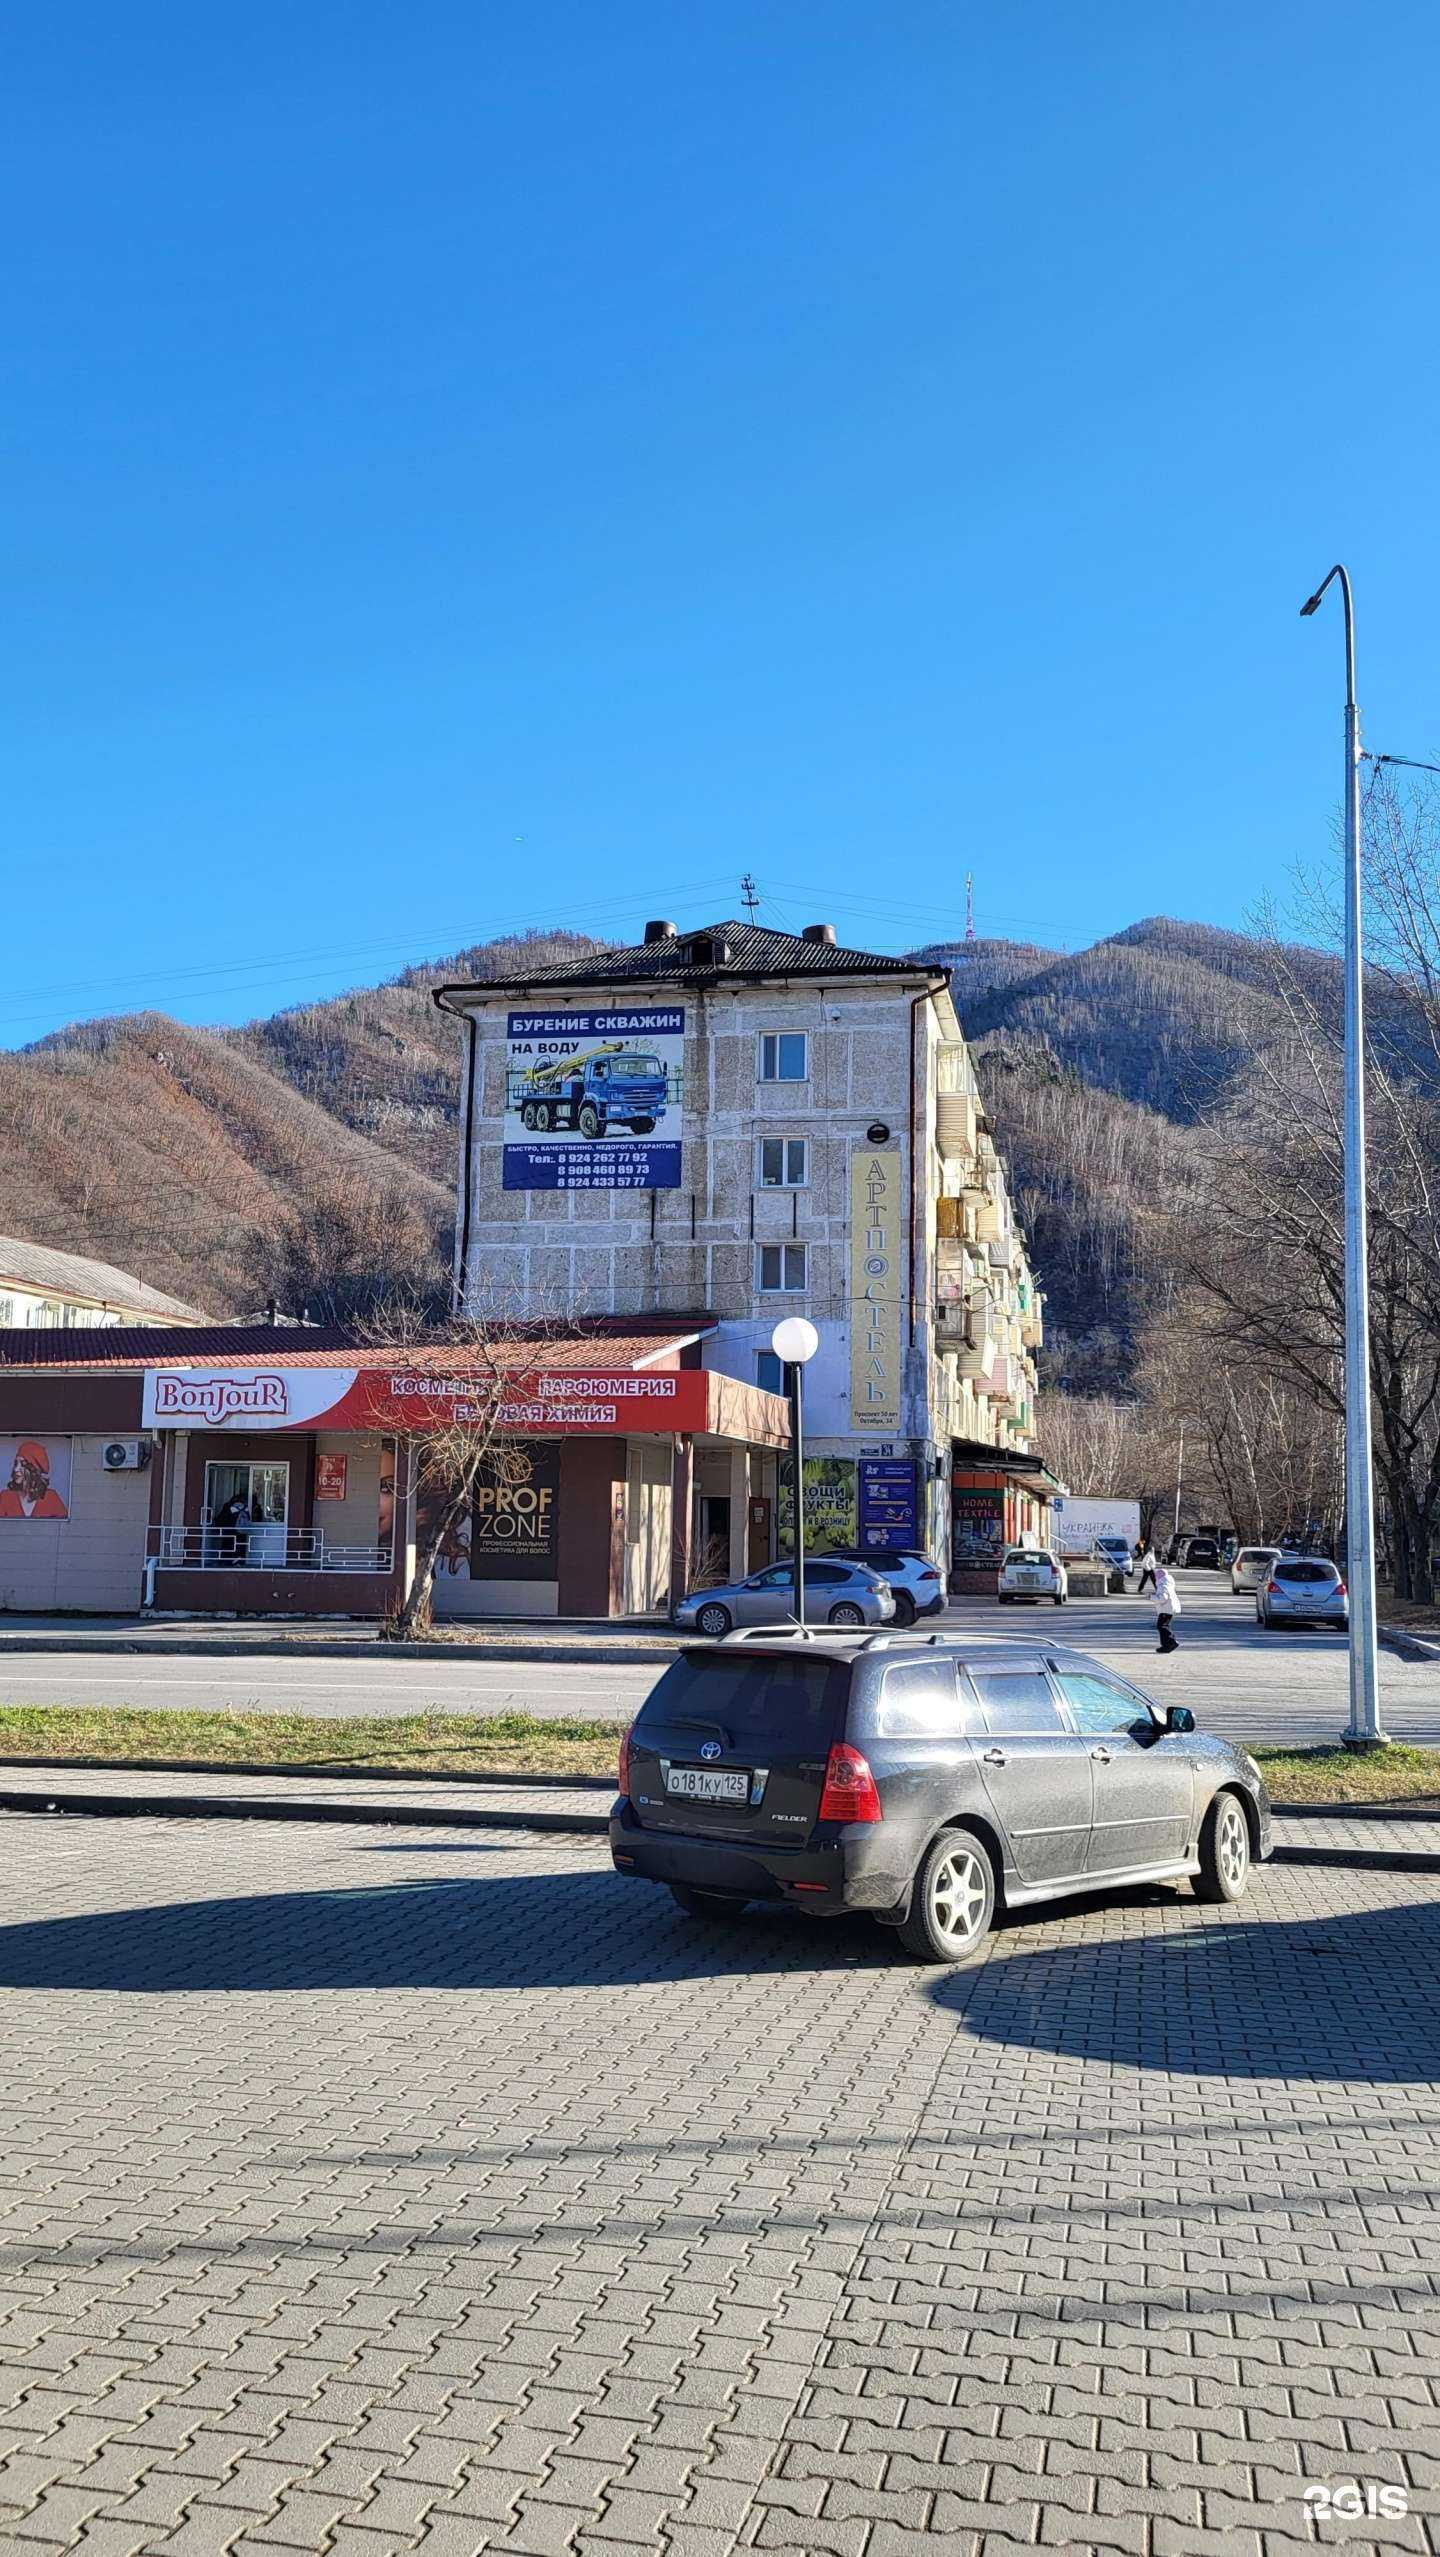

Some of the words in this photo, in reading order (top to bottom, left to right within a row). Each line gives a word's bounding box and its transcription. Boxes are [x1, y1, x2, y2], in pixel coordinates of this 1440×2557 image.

[512, 1017, 590, 1032] БУРЕНИЕ
[594, 1014, 681, 1030] СКВАЖИН
[511, 1043, 533, 1054] НА
[538, 1041, 580, 1055] ВОДУ
[569, 1153, 591, 1163] 924
[593, 1153, 615, 1162] 262
[618, 1153, 630, 1162] 77
[632, 1153, 648, 1162] 92
[593, 1165, 616, 1174] 460
[618, 1165, 633, 1174] 89
[636, 1164, 649, 1174] 73
[568, 1178, 590, 1187] 924
[592, 1177, 615, 1187] 433
[617, 1177, 631, 1187] 57
[633, 1177, 645, 1186] 77
[539, 1378, 676, 1396] ПАРФЮМЕРИЯ
[162, 1382, 281, 1417] BonJouR
[546, 1404, 617, 1422] ХИМИЯ
[479, 1487, 552, 1513] PROF
[963, 1498, 994, 1507] HOME
[479, 1514, 551, 1538] ZONE
[771, 1813, 809, 1823] FIELDER
